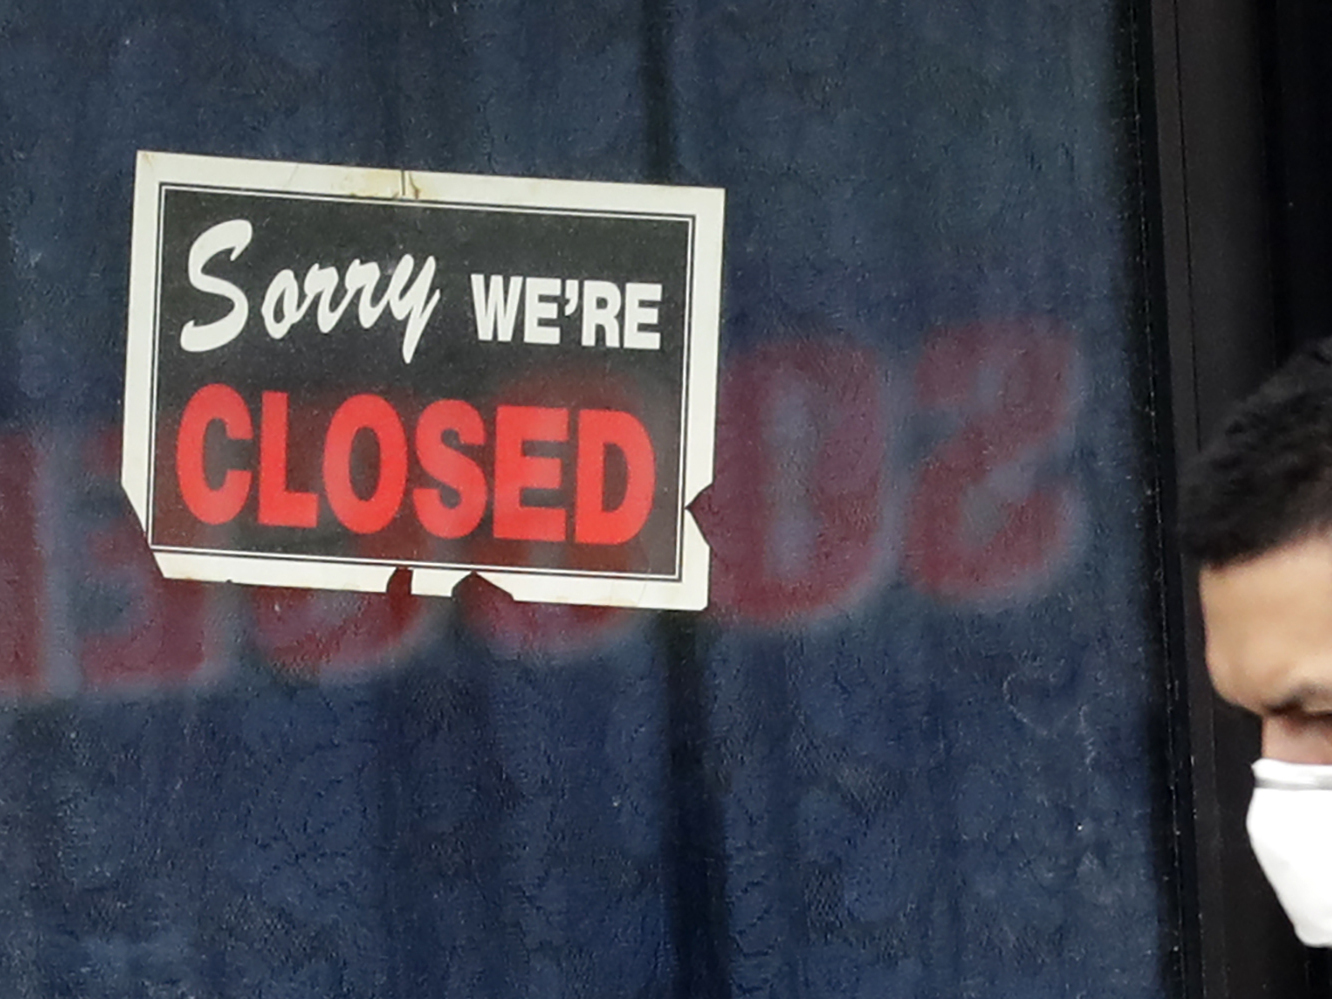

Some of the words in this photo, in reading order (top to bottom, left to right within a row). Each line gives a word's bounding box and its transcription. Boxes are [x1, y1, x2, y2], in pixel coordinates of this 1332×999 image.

[179, 218, 441, 364] Sorry
[470, 273, 663, 350] WE'RE
[175, 383, 657, 546] CLOSED
